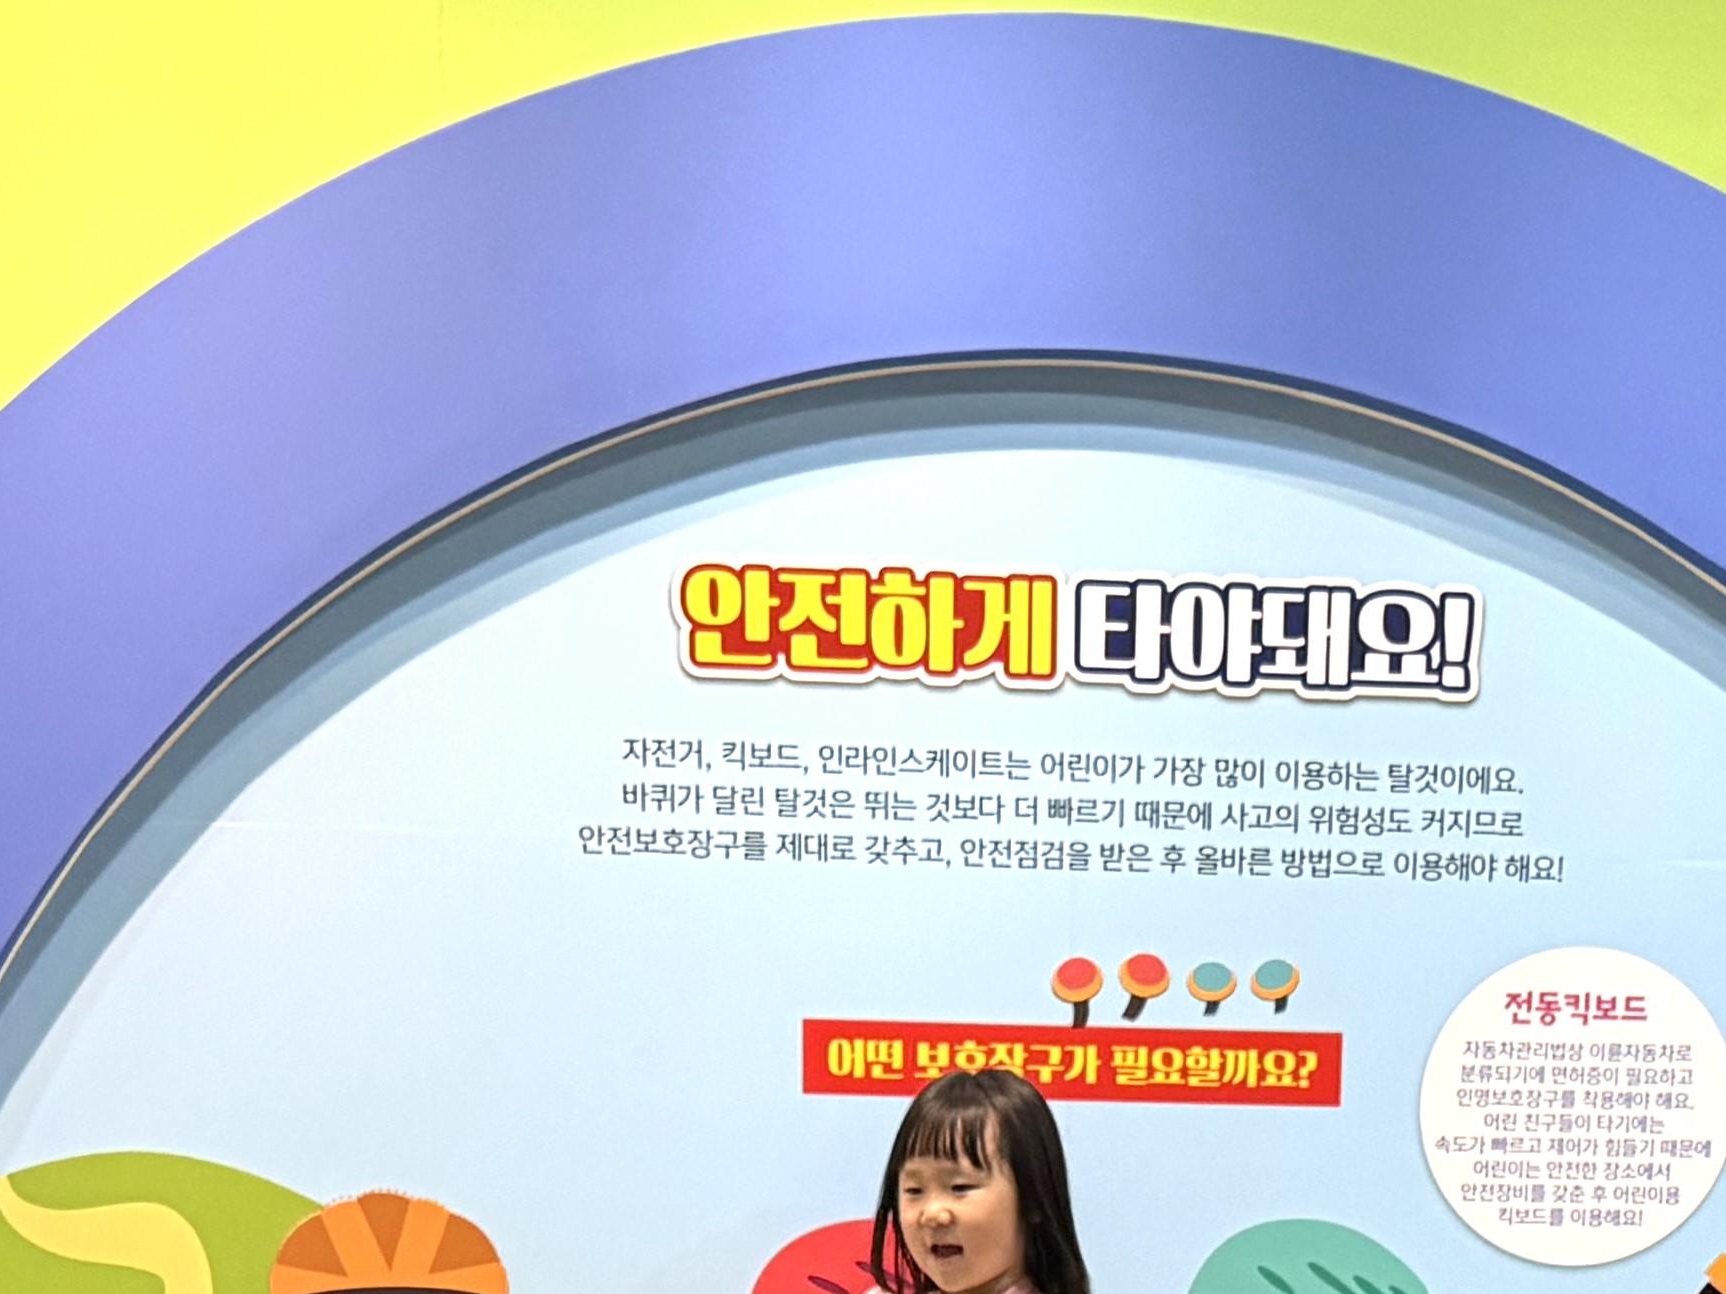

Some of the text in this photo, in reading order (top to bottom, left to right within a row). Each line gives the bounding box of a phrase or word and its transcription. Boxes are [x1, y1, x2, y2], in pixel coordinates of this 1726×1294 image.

[684, 564, 1470, 690] 안전하게 타야돼요!
[622, 737, 1524, 796] 자전거, 킥보드, 인라인스케이트는 어린이가 가장 많이 이용하는 탈것이에요.
[622, 782, 1524, 839] 바퀴가 달린 탈것은 뛰는 것보다 더 빠르기 때문에 사고의 위험성도 커지므로
[578, 825, 1564, 884] 안전보호장구를 제대로 갖추고, 안전점검을 받은 후 올바른 방법으로 이용해야 해요!
[1504, 990, 1648, 1027] 전동킥보드
[1462, 1041, 1692, 1062] 자동차관리법상 이륜자동차로
[827, 1038, 903, 1080] 어떤
[1111, 1044, 1319, 1089] 필요할까요?
[1461, 1065, 1692, 1086] 분류되기에 면허증이 필요하고
[1457, 1089, 1694, 1110] 인명보호장구를 착용해야 해요.
[1485, 1114, 1665, 1134] 어린 친구들이 타기에는
[1435, 1136, 1712, 1158] 속도가 빠르고 제어가 힘들기 때문에
[1474, 1160, 1671, 1181] 어린이는 안전한 장소에서
[1461, 1183, 1680, 1205] 안전장비를 갖춘 후 어린이용
[1499, 1208, 1643, 1227] 킥보드를 이용해요!
